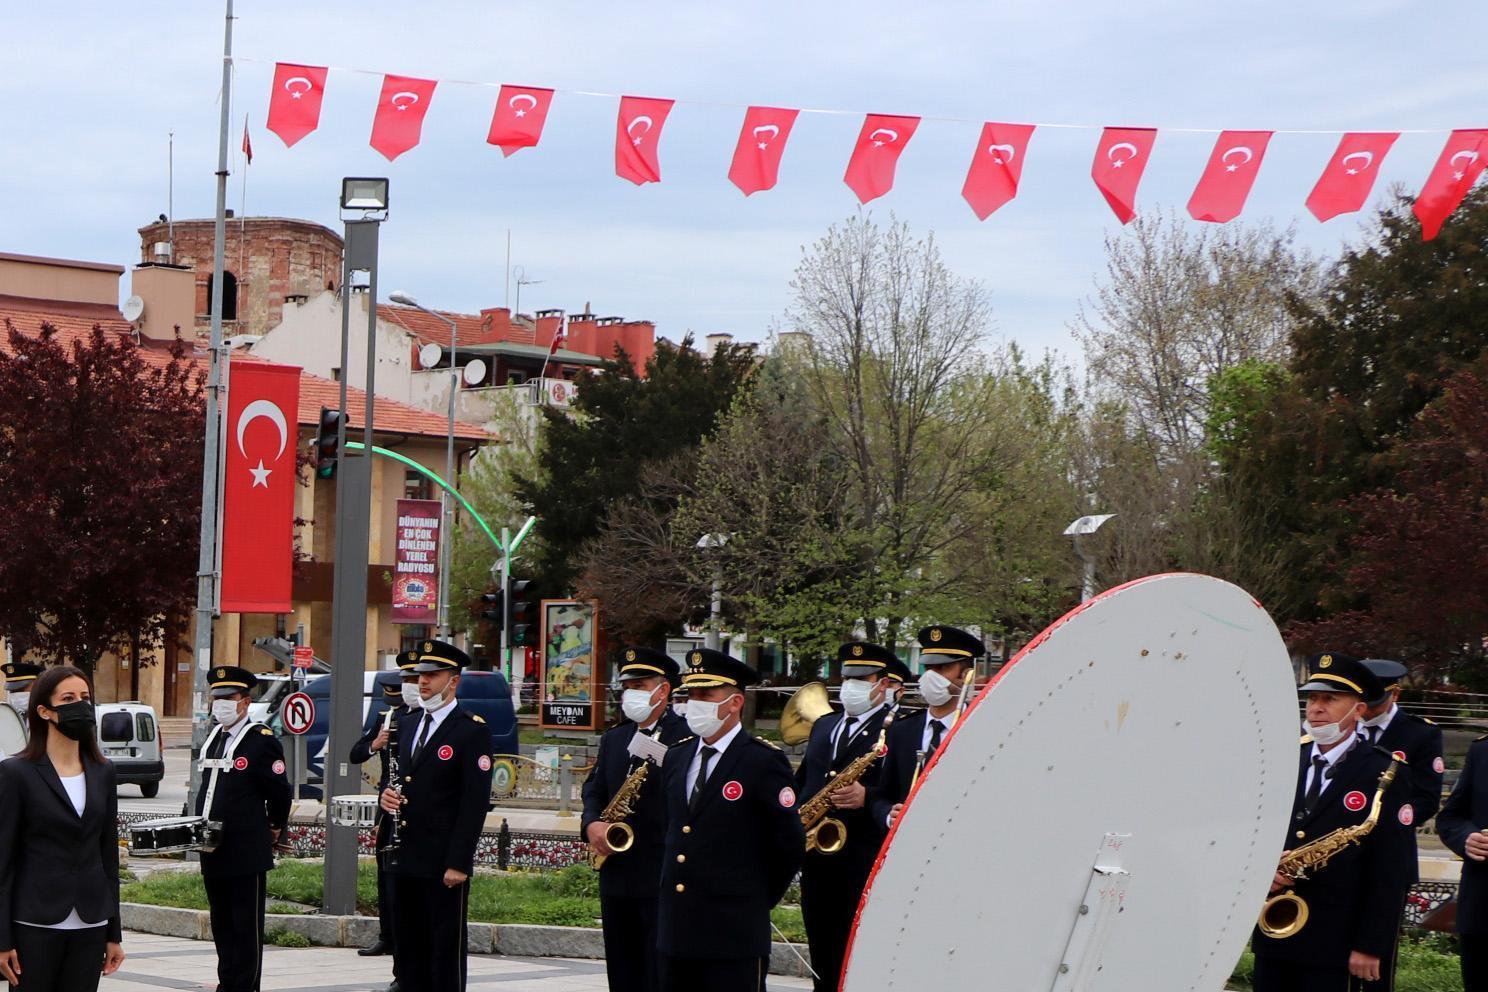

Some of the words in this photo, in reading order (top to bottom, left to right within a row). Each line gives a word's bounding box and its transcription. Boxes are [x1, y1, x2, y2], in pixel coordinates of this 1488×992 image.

[398, 516, 439, 528] DÜNYANIN
[404, 529, 413, 538] EN
[415, 529, 432, 540] ÇOK
[406, 551, 427, 561] YEREL
[398, 562, 434, 573] RADYOSU
[550, 706, 584, 716] MEYDAN
[556, 715, 577, 725] CAFE
